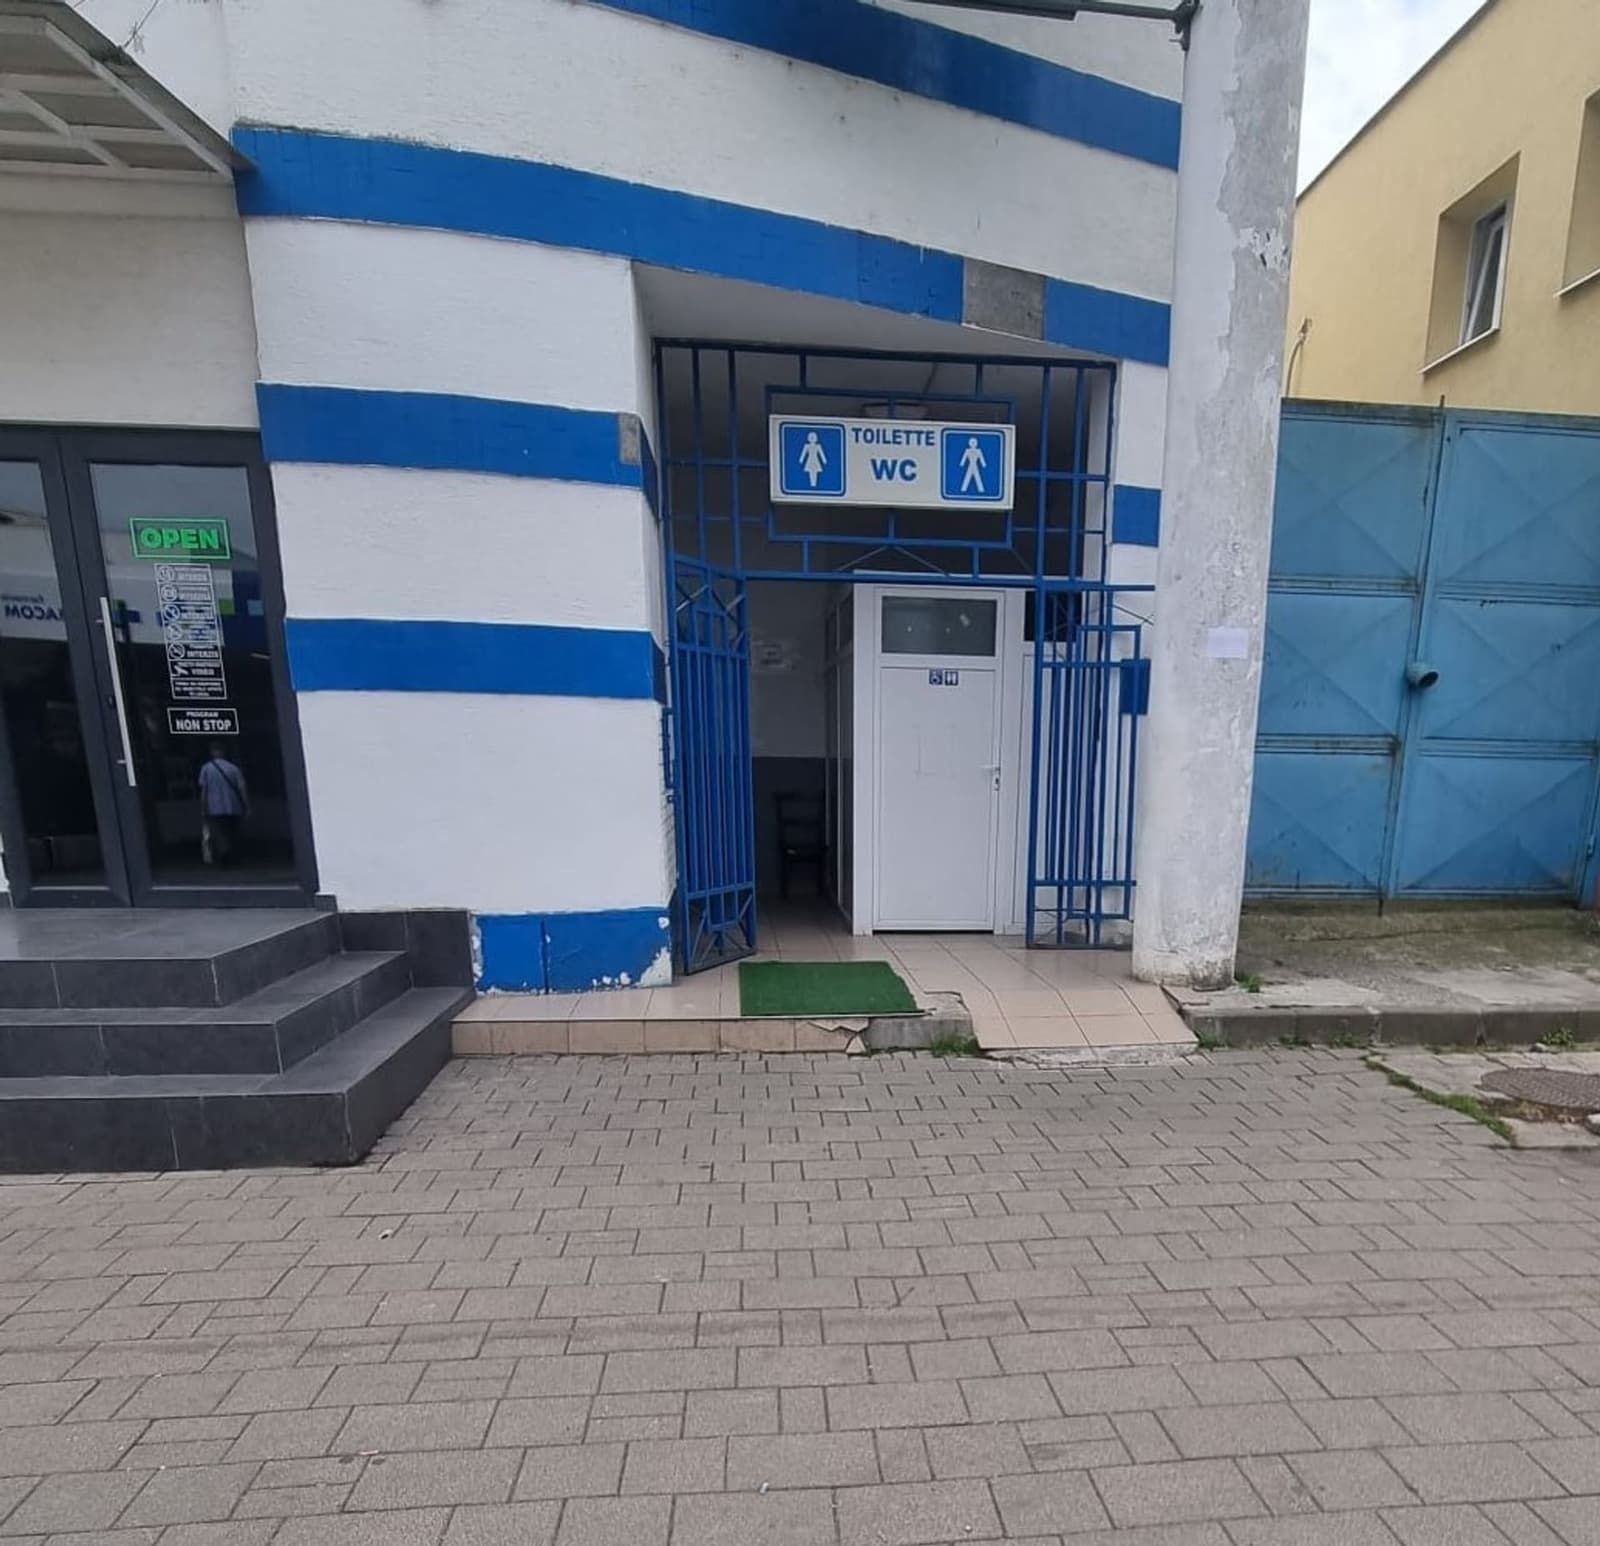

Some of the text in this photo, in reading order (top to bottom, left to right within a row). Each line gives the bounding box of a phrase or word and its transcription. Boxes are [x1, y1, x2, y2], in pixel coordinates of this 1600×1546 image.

[851, 427, 936, 446] TOILETTE
[870, 458, 917, 481] WC
[140, 527, 219, 549] OPEN
[176, 719, 232, 731] NON STOP
